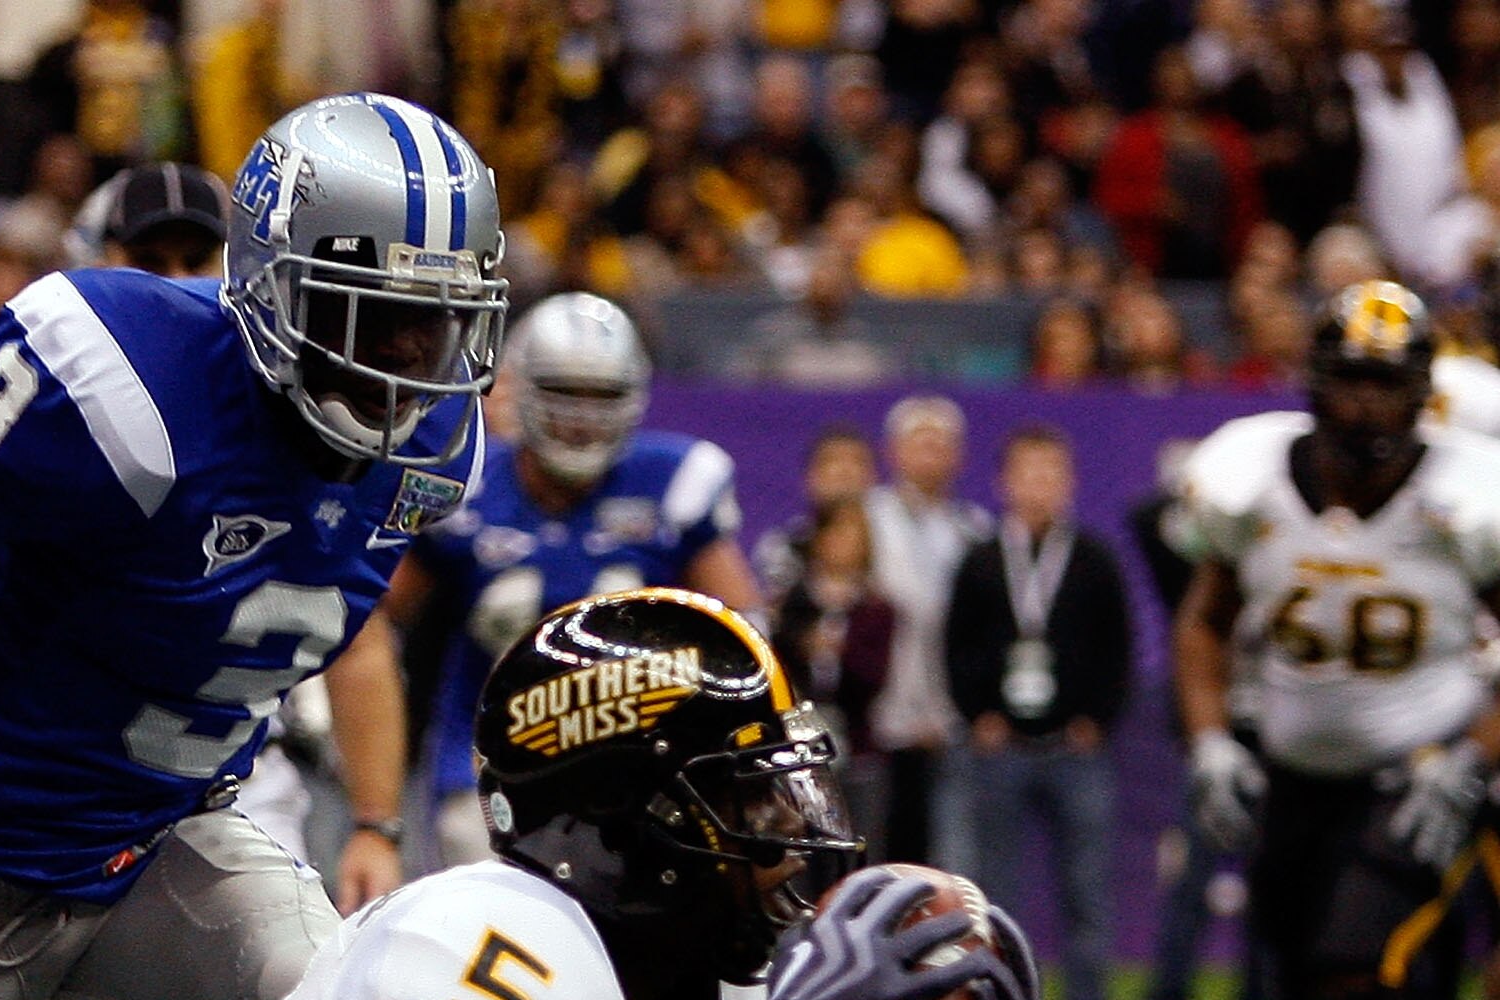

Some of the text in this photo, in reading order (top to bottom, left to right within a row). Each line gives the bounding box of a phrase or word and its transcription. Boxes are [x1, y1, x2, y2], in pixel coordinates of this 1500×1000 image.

[332, 236, 360, 252] NIKE
[121, 580, 349, 779] 3
[507, 647, 702, 736] SOUTHERN
[559, 695, 640, 752] MISS
